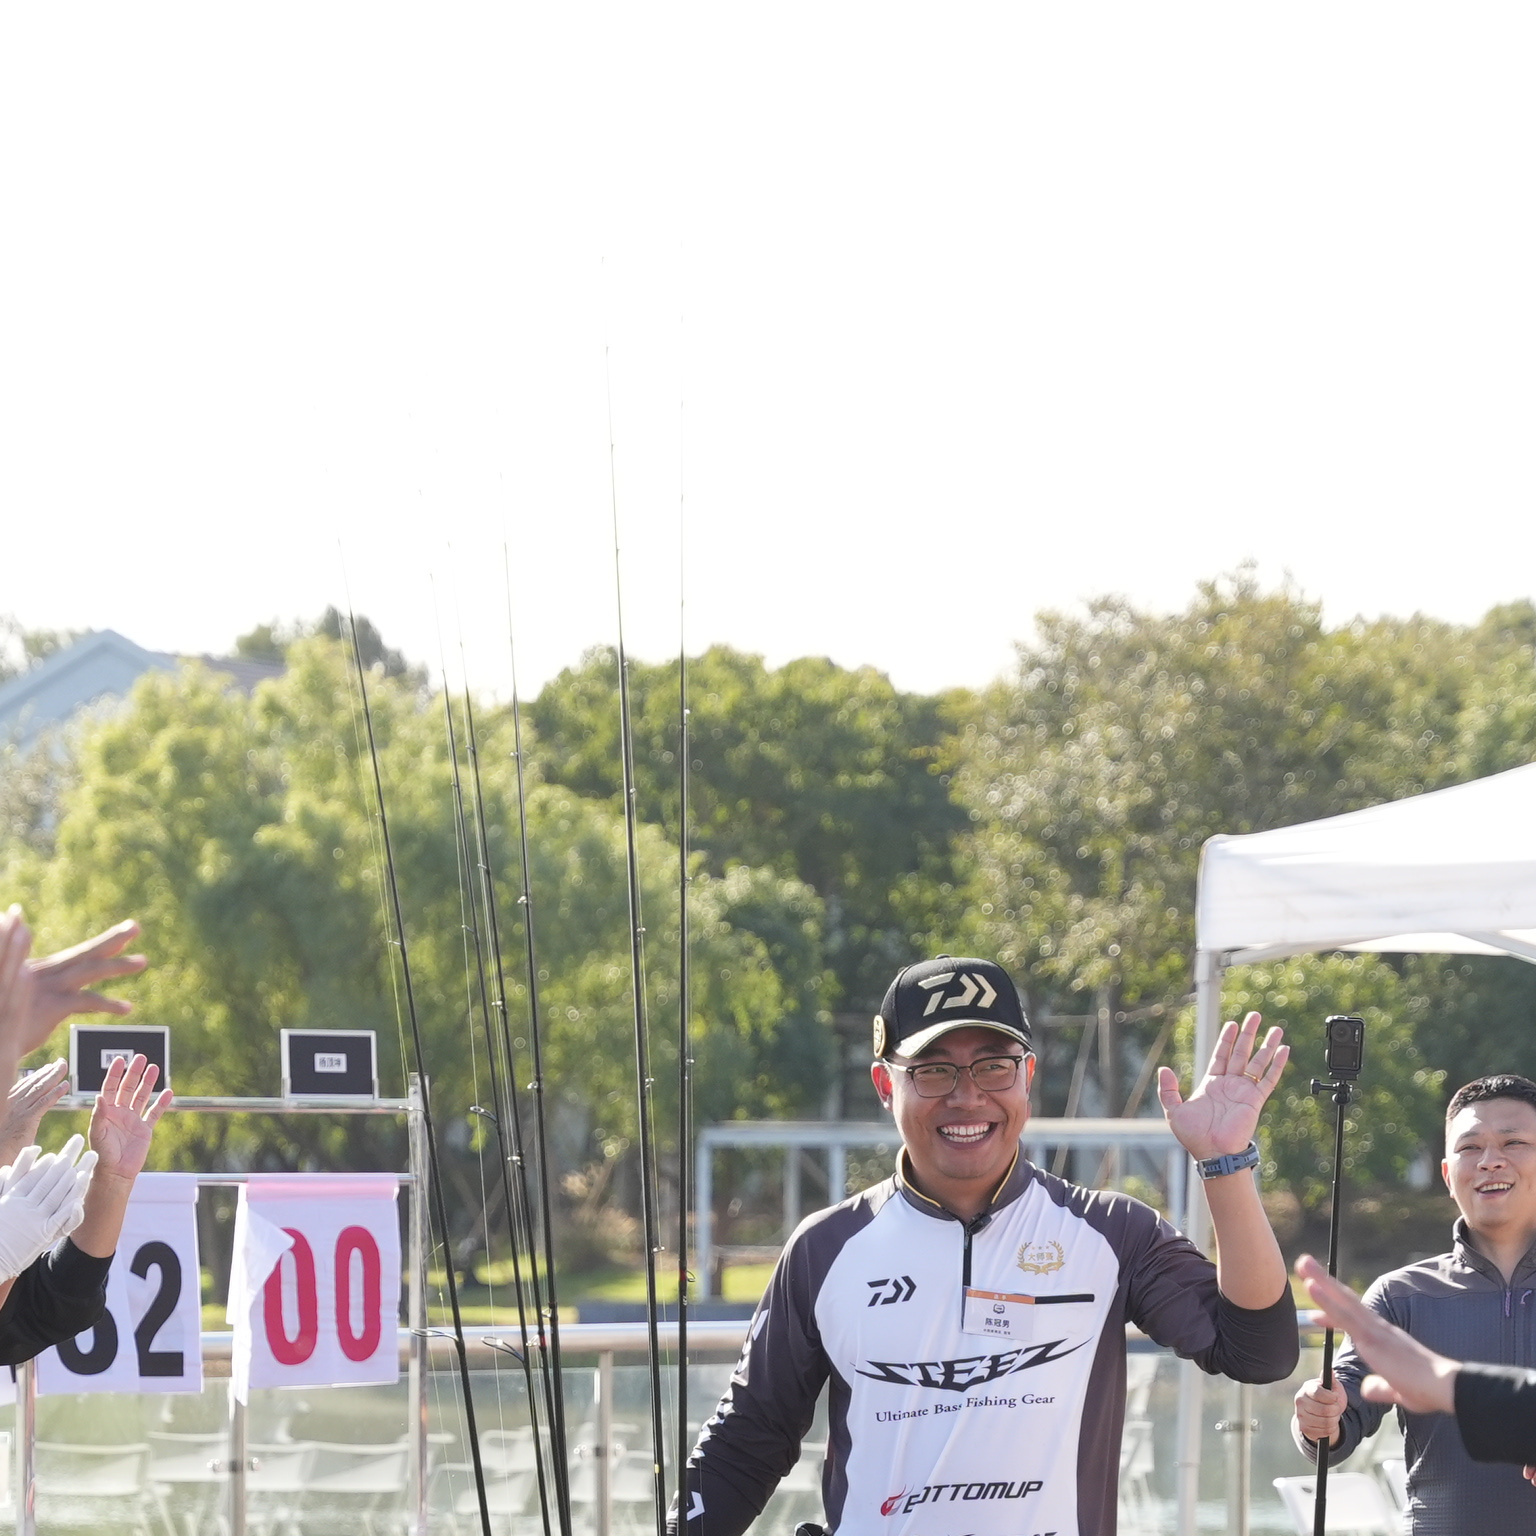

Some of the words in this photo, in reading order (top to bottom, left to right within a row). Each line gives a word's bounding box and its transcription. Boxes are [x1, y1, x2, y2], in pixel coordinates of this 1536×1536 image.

[264, 1225, 381, 1366] 00
[985, 1317, 1010, 1329] 陈冠男
[850, 1337, 1094, 1393] STEEZ
[966, 1396, 1017, 1409] Fishing
[1021, 1393, 1056, 1405] Gear
